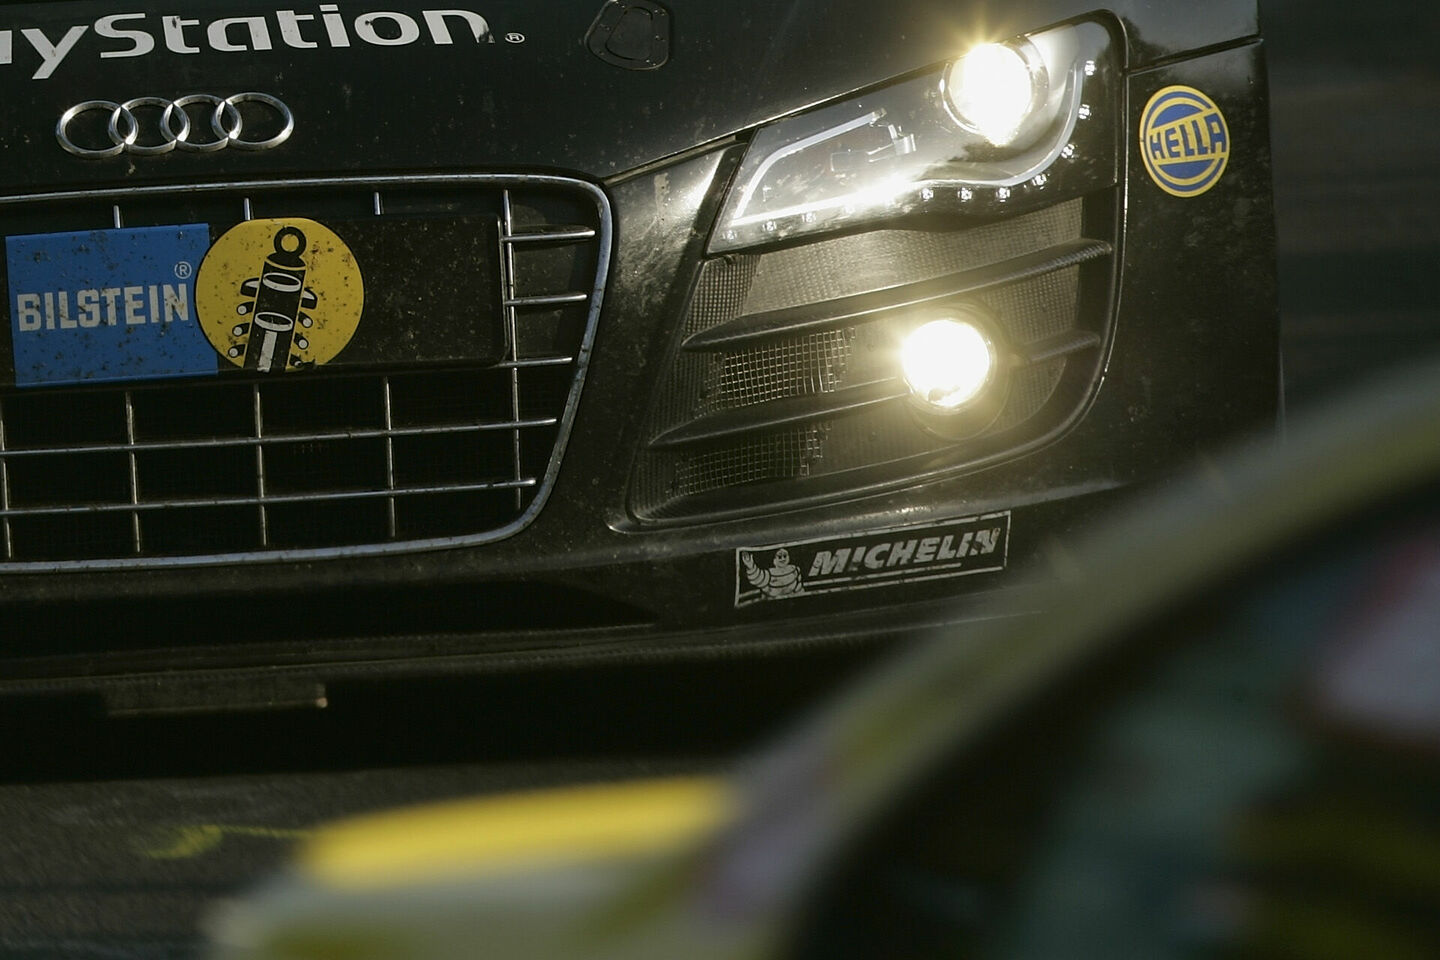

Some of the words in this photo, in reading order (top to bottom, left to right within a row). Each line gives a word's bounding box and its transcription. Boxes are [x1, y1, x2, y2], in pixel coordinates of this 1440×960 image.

[1149, 112, 1227, 160] HELLA
[15, 283, 190, 333] BILSTEIN
[807, 527, 1002, 577] MICHELIN
